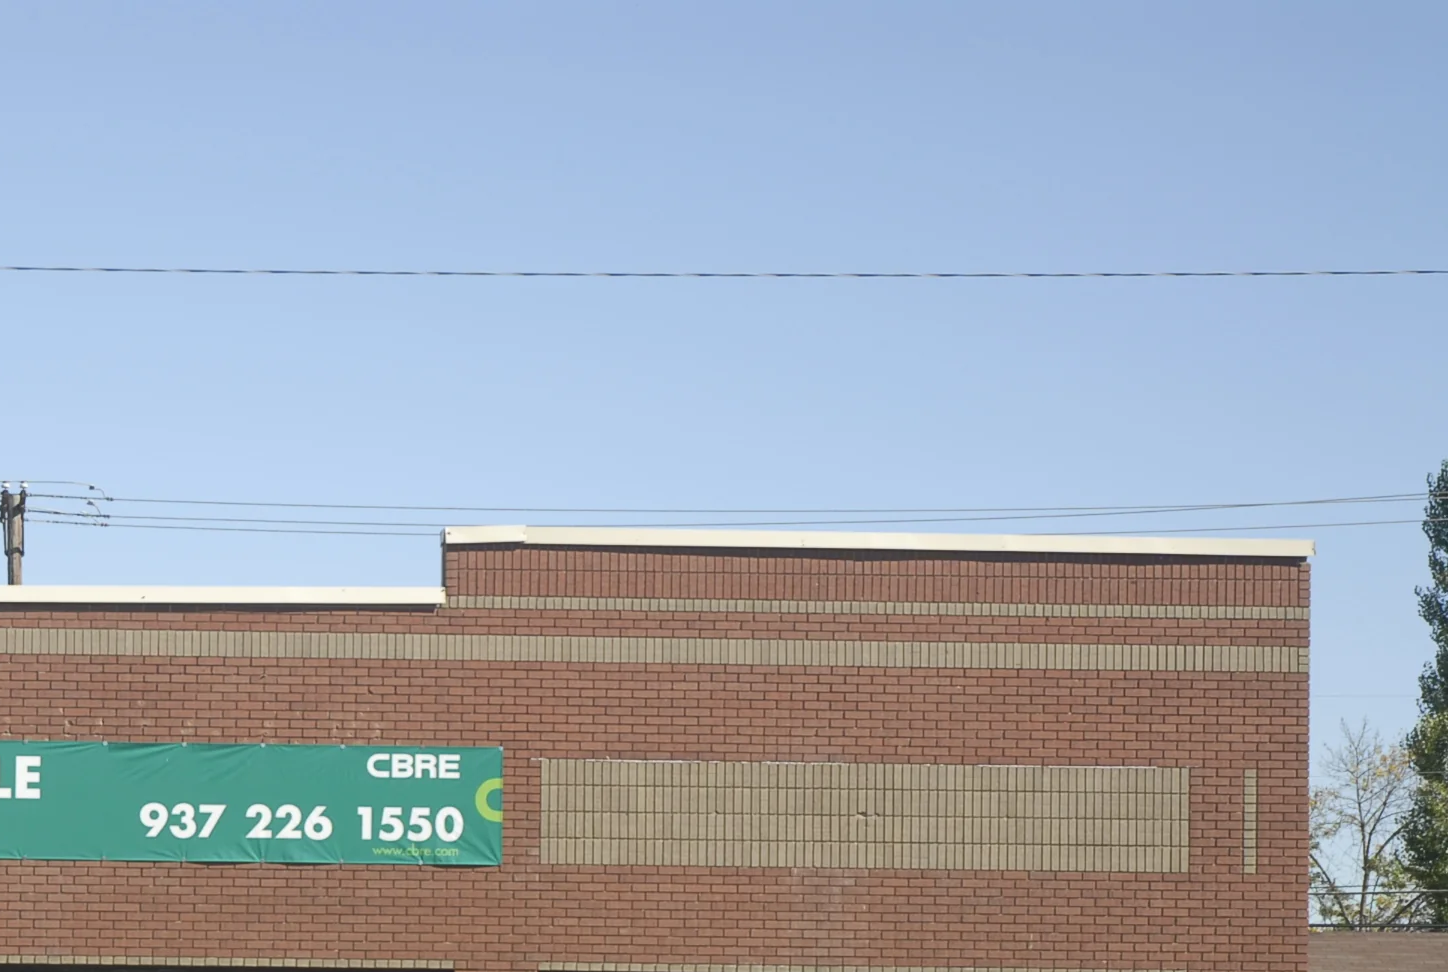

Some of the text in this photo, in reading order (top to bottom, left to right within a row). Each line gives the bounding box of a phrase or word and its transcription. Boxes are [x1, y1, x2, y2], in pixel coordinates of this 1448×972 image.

[366, 753, 461, 780] CBRE
[139, 802, 464, 842] 937 226 1550
[372, 843, 459, 857] www.cbre.com
